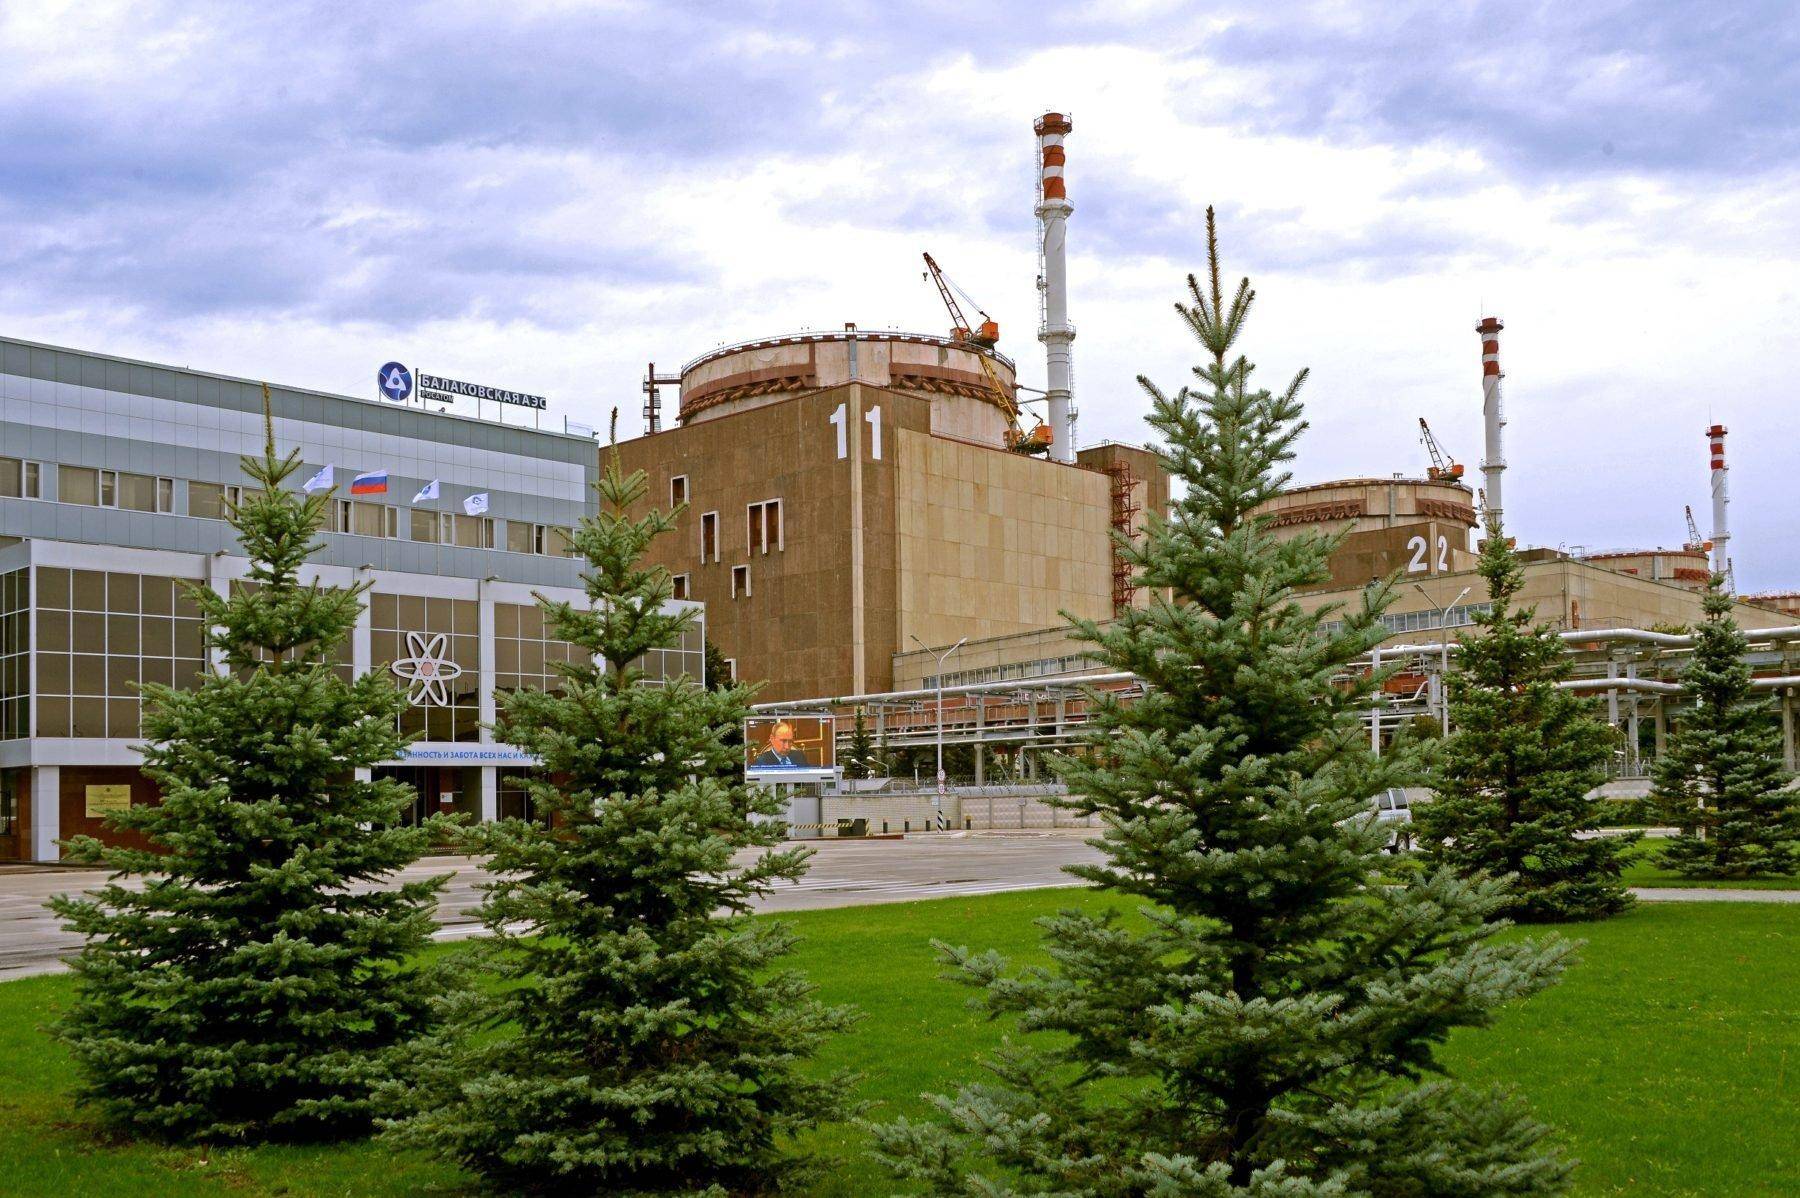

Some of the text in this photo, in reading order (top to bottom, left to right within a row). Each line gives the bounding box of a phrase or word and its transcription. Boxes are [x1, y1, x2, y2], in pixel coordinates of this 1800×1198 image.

[421, 390, 454, 402] РОСАТОМ
[422, 374, 547, 409] БАЛАКОВСКАЯ АЭС
[443, 751, 449, 759] И
[450, 751, 479, 759] ЗАБОТА
[479, 751, 497, 759] ВСЕХ
